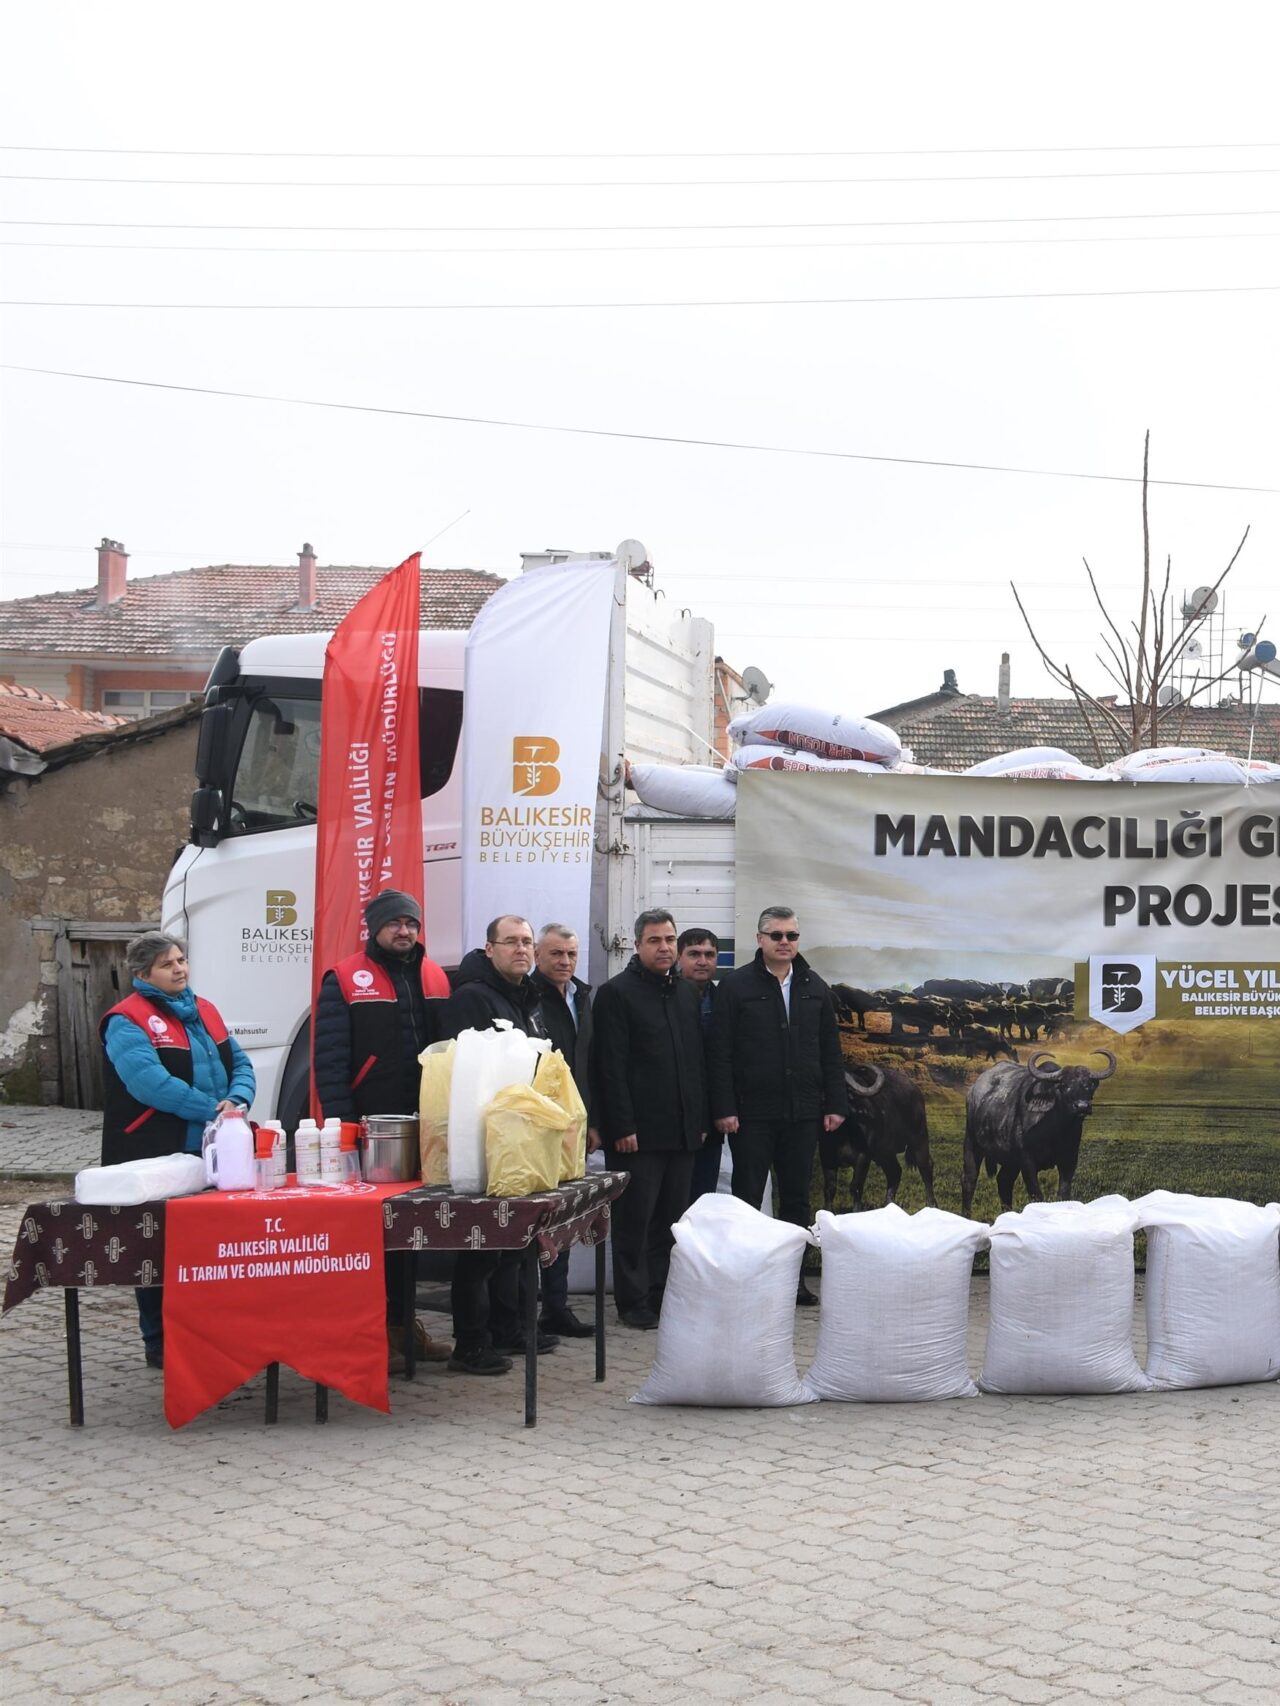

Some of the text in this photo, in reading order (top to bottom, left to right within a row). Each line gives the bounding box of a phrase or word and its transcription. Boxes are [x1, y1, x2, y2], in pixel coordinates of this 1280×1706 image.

[481, 803, 592, 827] BALIKESİR
[480, 829, 590, 851] BÜYÜKŞEHİR
[873, 810, 1223, 859] MANDACILIĞI
[354, 836, 375, 942] BAIKESİR
[1160, 965, 1240, 989] YÜCEL
[1181, 989, 1241, 1002] BALIKESİR
[1194, 1003, 1248, 1016] BELEDİYE
[264, 1218, 286, 1233] T.C.
[218, 1233, 330, 1258] BALIKESİR VALİLİĞİ
[178, 1265, 189, 1283] İL
[192, 1265, 228, 1282] TARIM
[230, 1264, 245, 1280] VE
[247, 1261, 291, 1278] ORMAN
[293, 1253, 371, 1275] MÜDÜRLÜĞÜ
